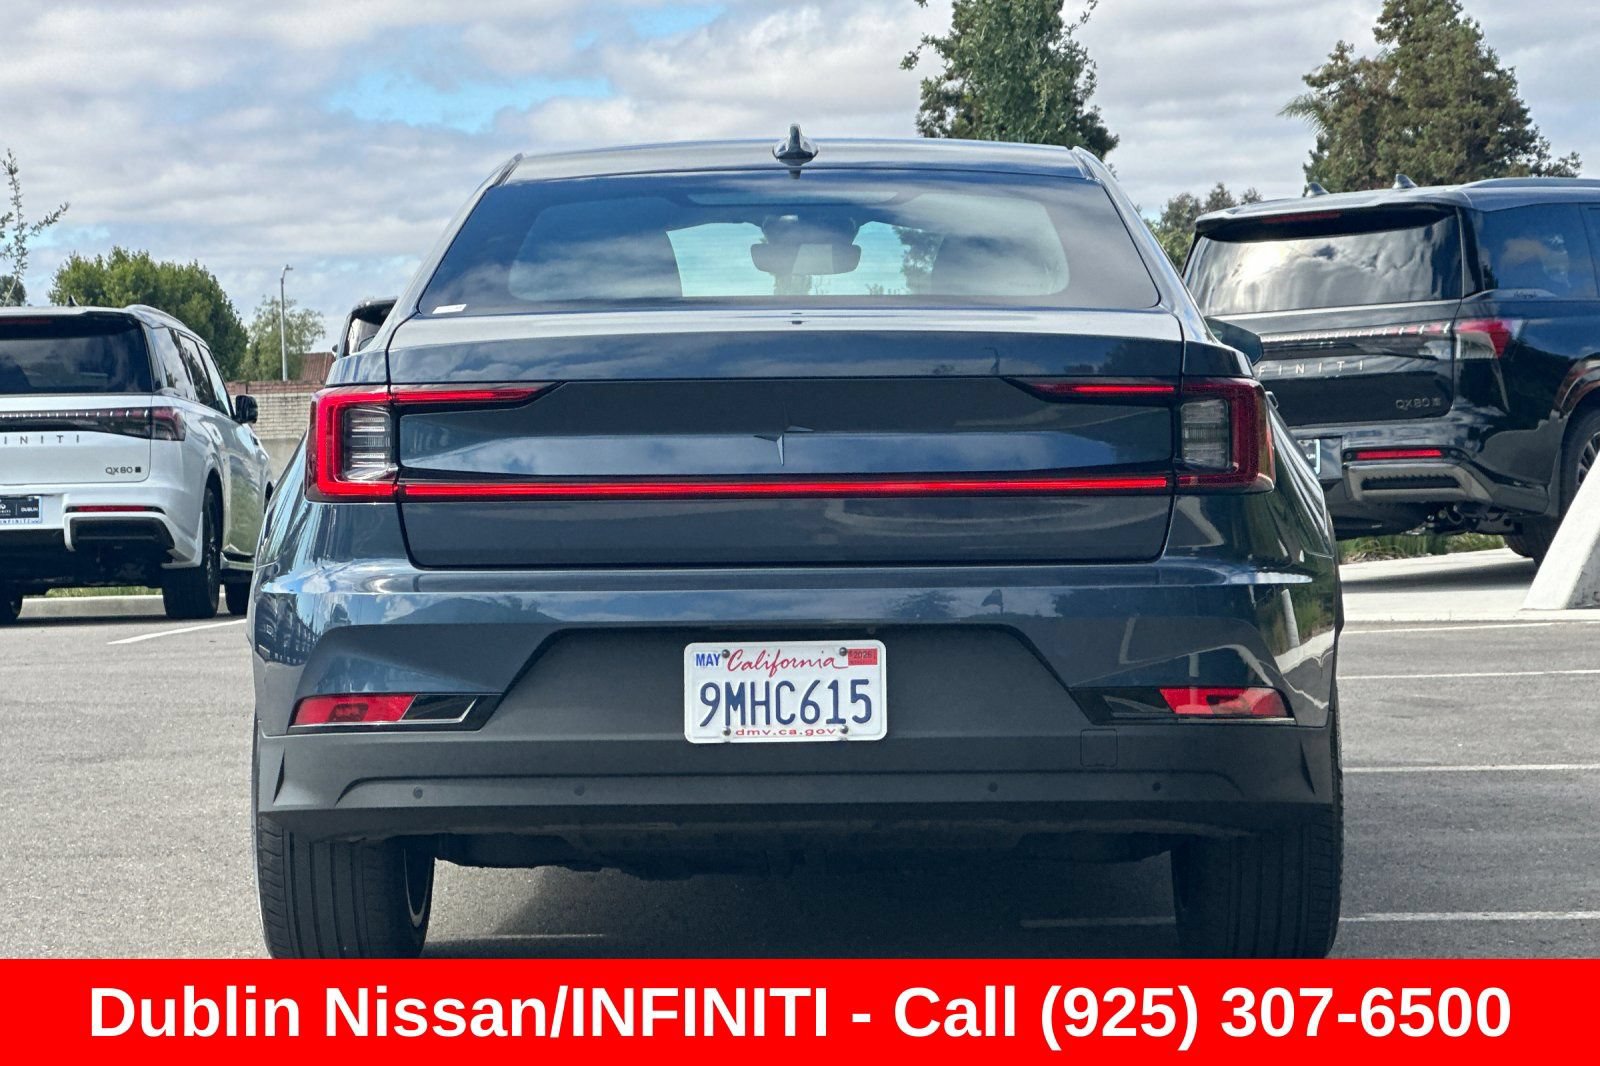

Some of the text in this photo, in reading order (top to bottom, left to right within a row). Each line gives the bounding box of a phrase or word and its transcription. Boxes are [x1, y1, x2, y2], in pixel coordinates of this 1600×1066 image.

[105, 466, 133, 475] QX80
[695, 653, 720, 667] MAY
[727, 649, 849, 678] California
[699, 679, 872, 727] 9MHC615
[735, 727, 837, 737] dmv.ca.gov
